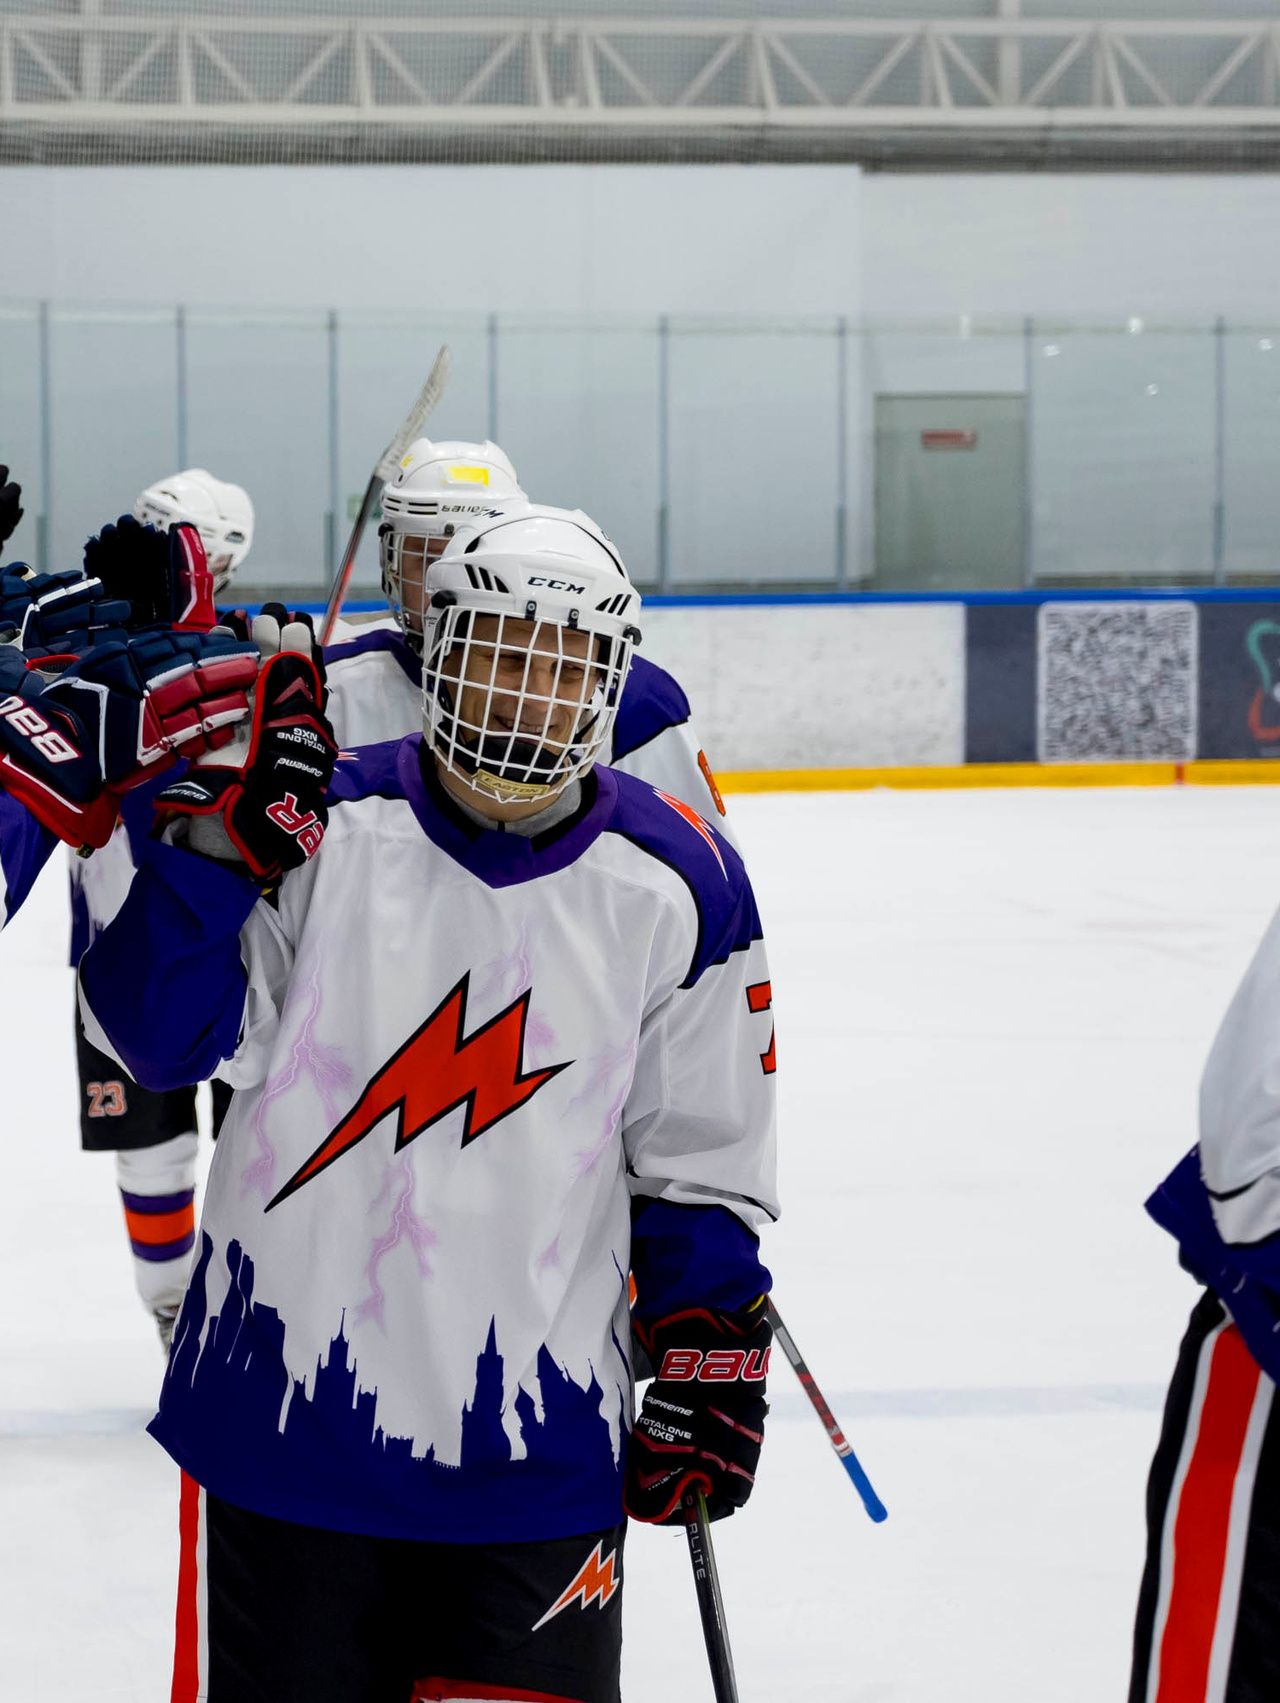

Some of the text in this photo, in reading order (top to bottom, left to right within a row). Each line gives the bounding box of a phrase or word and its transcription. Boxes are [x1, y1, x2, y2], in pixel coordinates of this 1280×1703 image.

[527, 576, 587, 595] CCM
[293, 727, 318, 741] NXG
[484, 777, 539, 793] EASTON
[87, 1080, 128, 1118] 23
[657, 1346, 772, 1382] BAU
[644, 1395, 694, 1416] SUPREME
[647, 1427, 675, 1442] NXG
